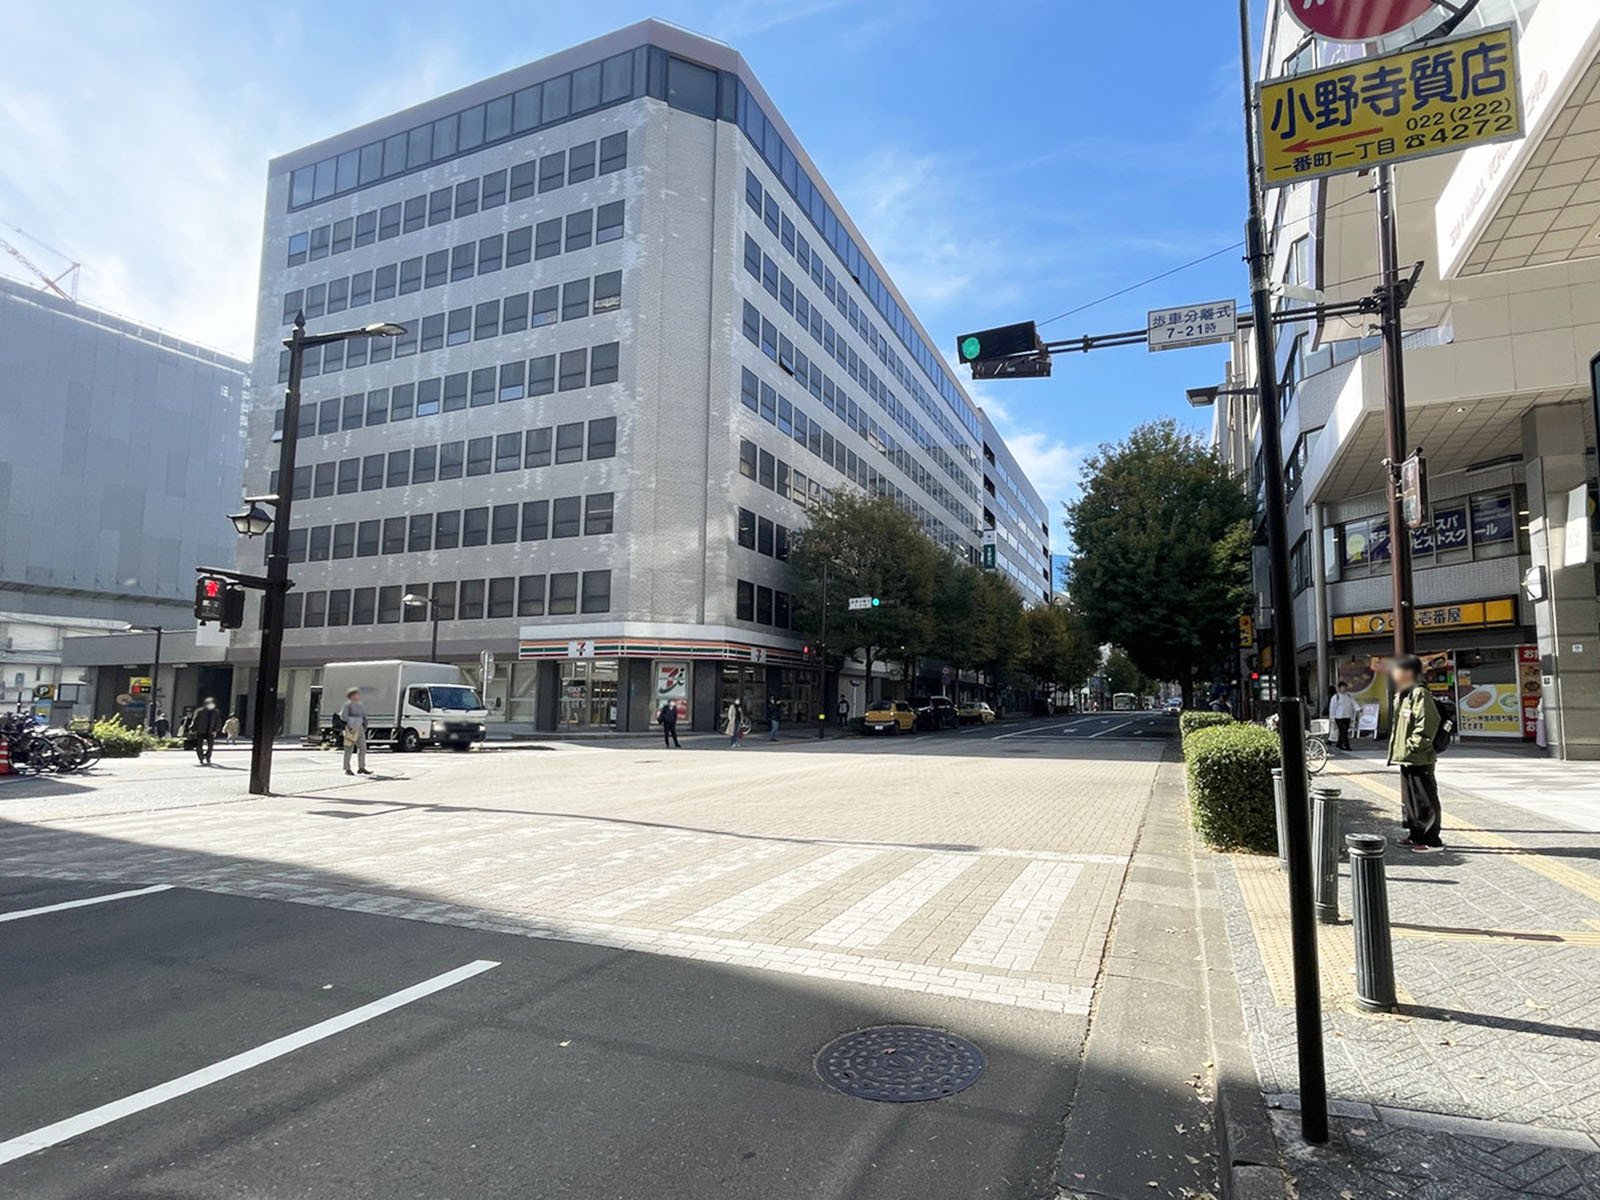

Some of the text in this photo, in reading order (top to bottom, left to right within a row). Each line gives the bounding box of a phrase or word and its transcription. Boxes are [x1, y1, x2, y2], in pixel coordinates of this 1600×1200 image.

[1270, 42, 1508, 139] 小野寺質店
[1272, 139, 1395, 174] 一番町一丁目
[1152, 305, 1232, 326] 歩車分離式
[1166, 323, 1217, 339] 7-21時
